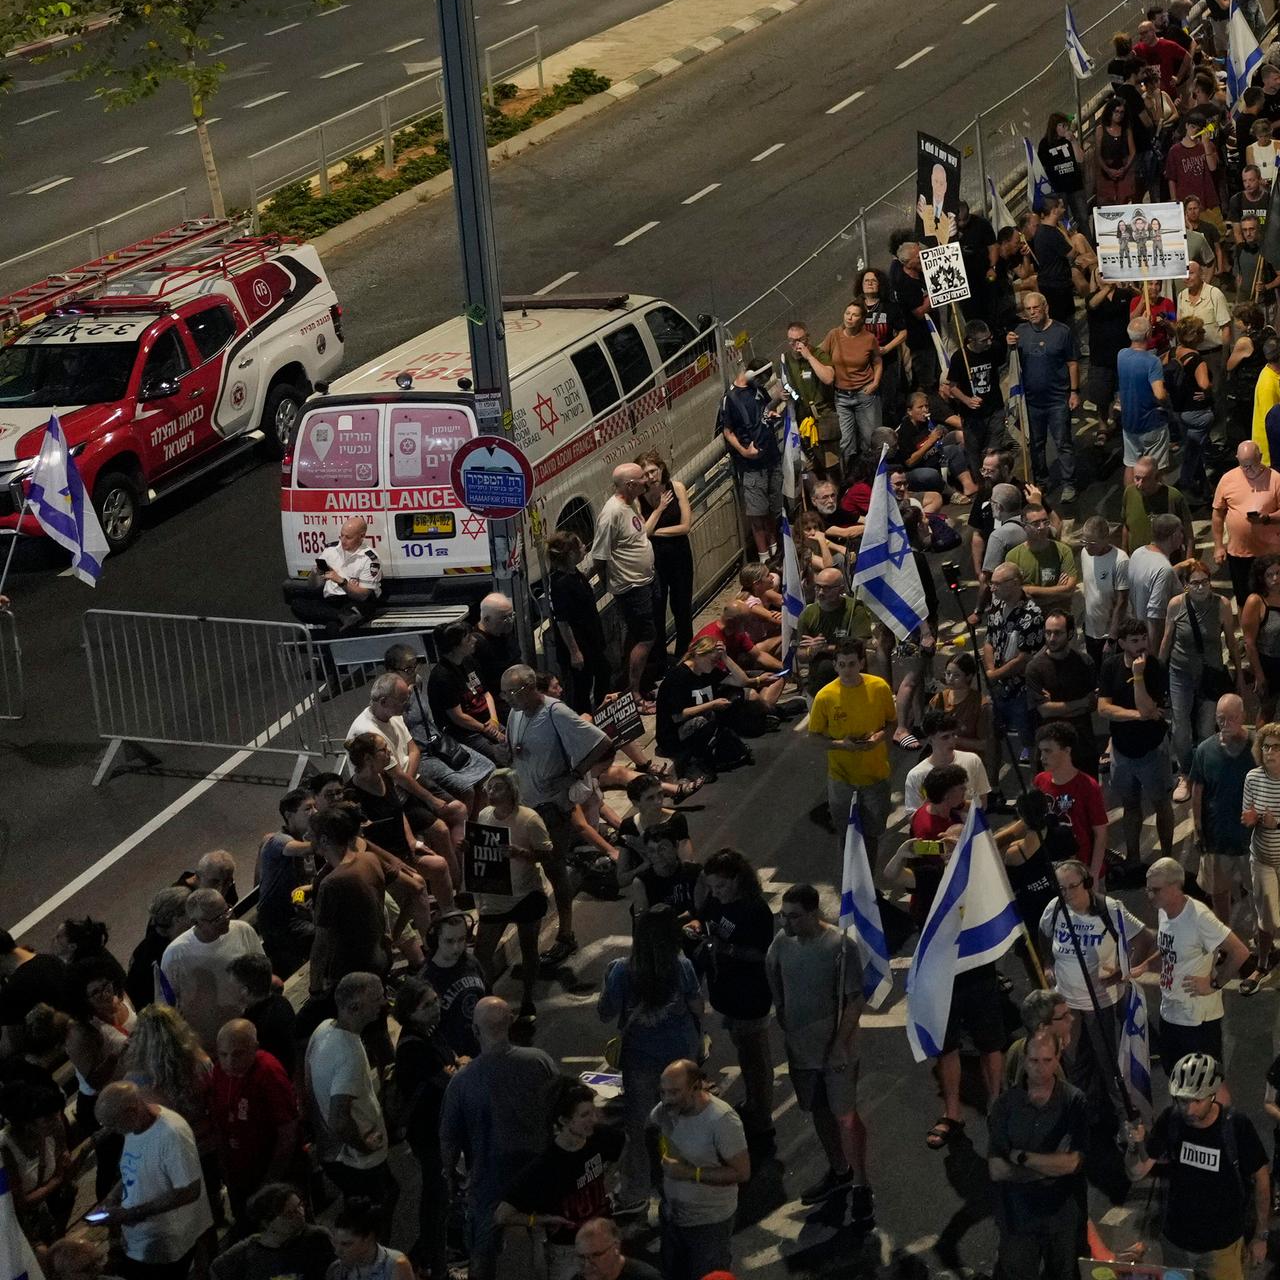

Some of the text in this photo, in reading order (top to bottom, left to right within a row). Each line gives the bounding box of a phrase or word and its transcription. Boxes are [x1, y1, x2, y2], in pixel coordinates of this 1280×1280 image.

[338, 444, 371, 456] עכשיו
[325, 491, 456, 510] AMBULANCE
[469, 493, 522, 505] HAMAFKIR STREET
[298, 531, 328, 555] 1583
[401, 542, 434, 558] 101
[482, 830, 501, 847] אל
[1182, 1146, 1218, 1168] כוסומו
